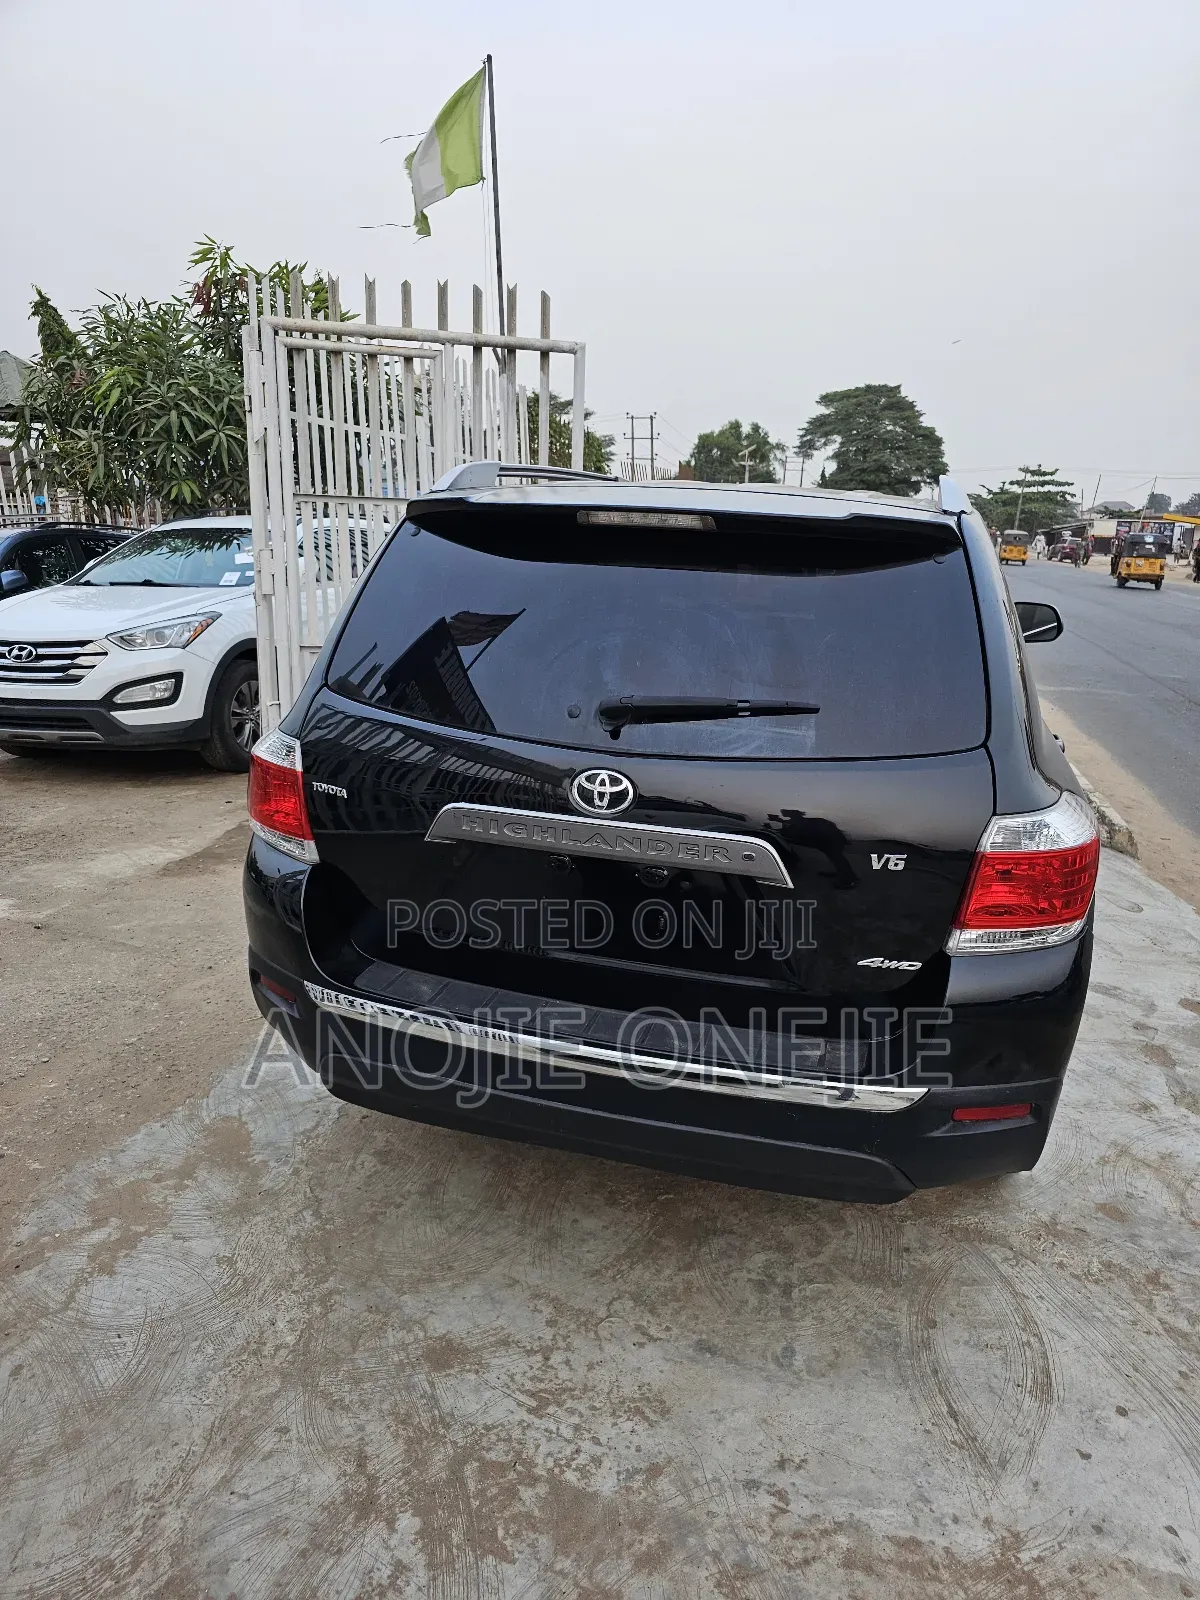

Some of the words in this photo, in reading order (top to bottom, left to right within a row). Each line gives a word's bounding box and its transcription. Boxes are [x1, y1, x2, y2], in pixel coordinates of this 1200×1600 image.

[311, 781, 348, 799] TOYOTA
[460, 814, 734, 864] HIGHLANDER
[870, 853, 908, 871] V6
[856, 957, 923, 971] 4WD
